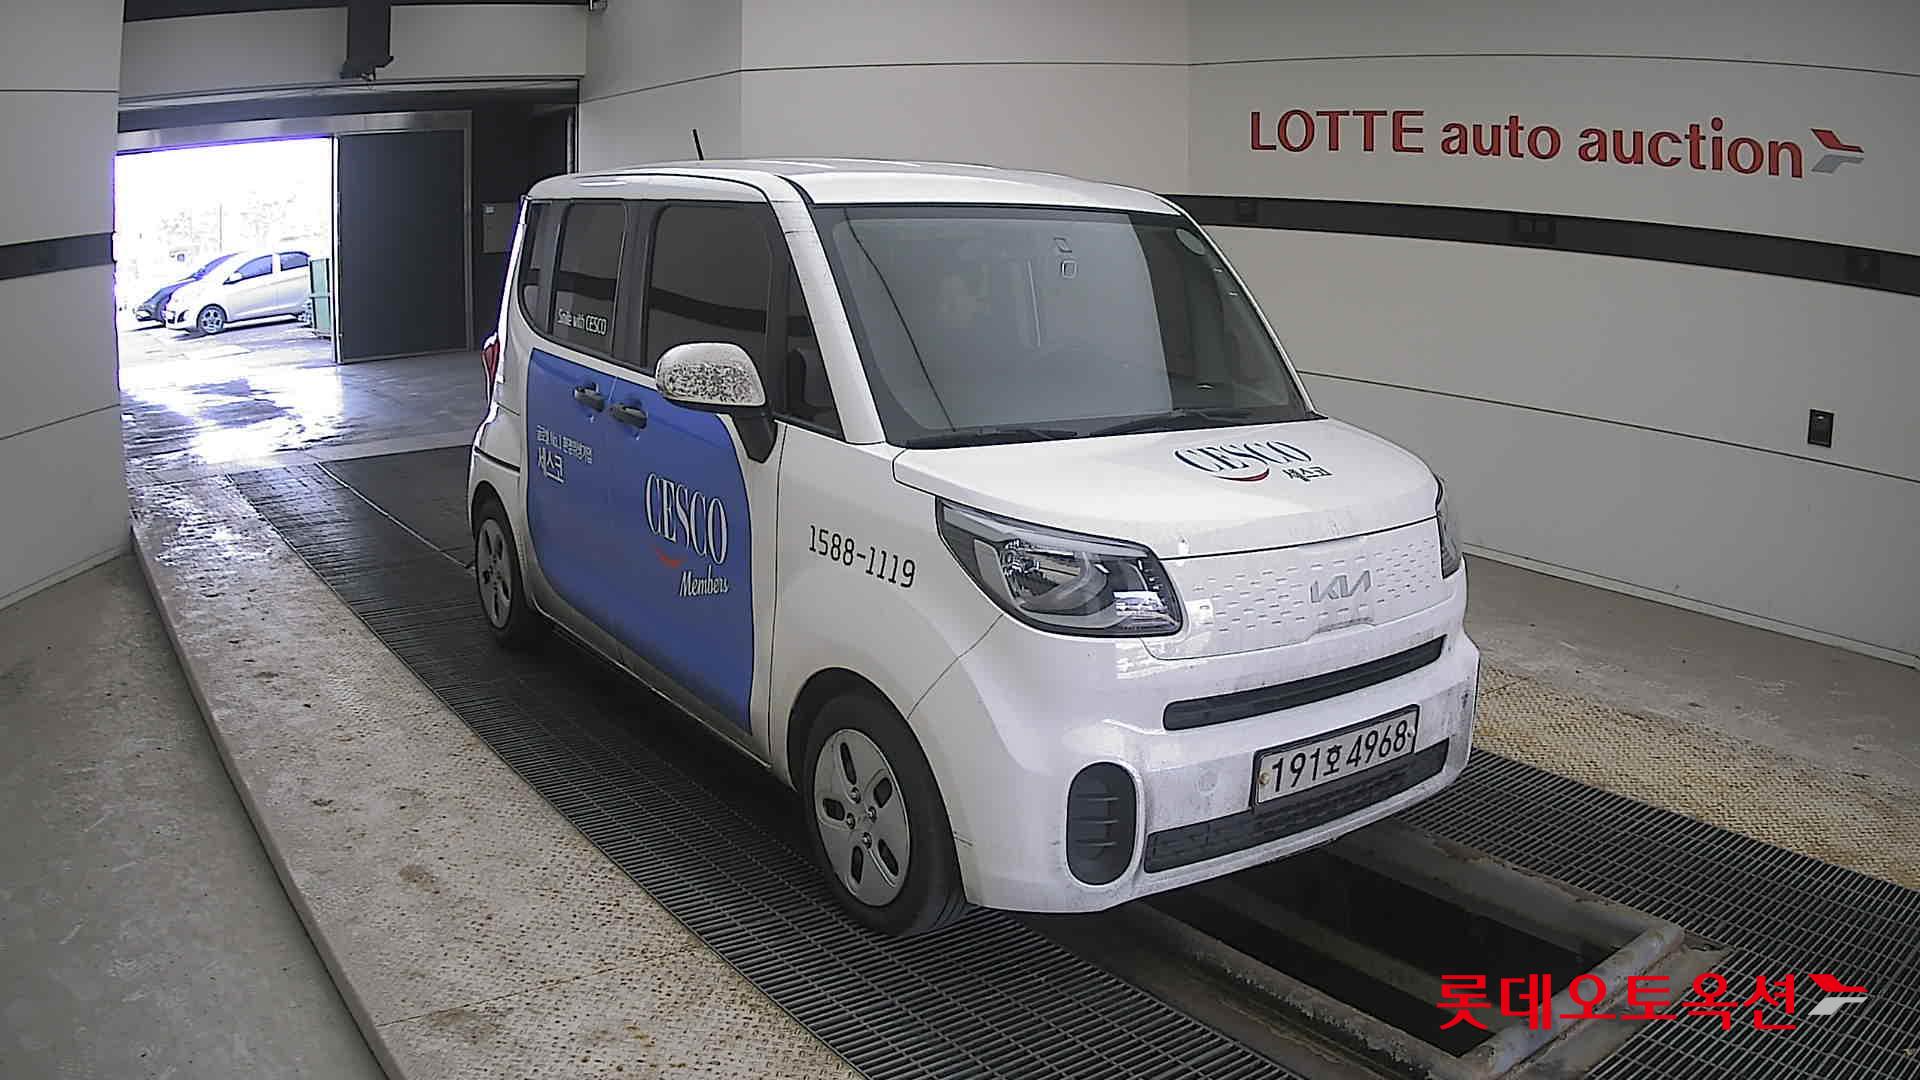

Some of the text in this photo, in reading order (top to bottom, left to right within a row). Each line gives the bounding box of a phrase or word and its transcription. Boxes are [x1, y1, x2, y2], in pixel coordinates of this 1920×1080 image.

[1250, 109, 1803, 179] LOTTE auto auction
[586, 315, 607, 335] CESCO
[1174, 441, 1312, 473] CESCO
[645, 473, 728, 564] CESCO
[679, 564, 729, 597] Members
[809, 525, 916, 588] 1588-1119
